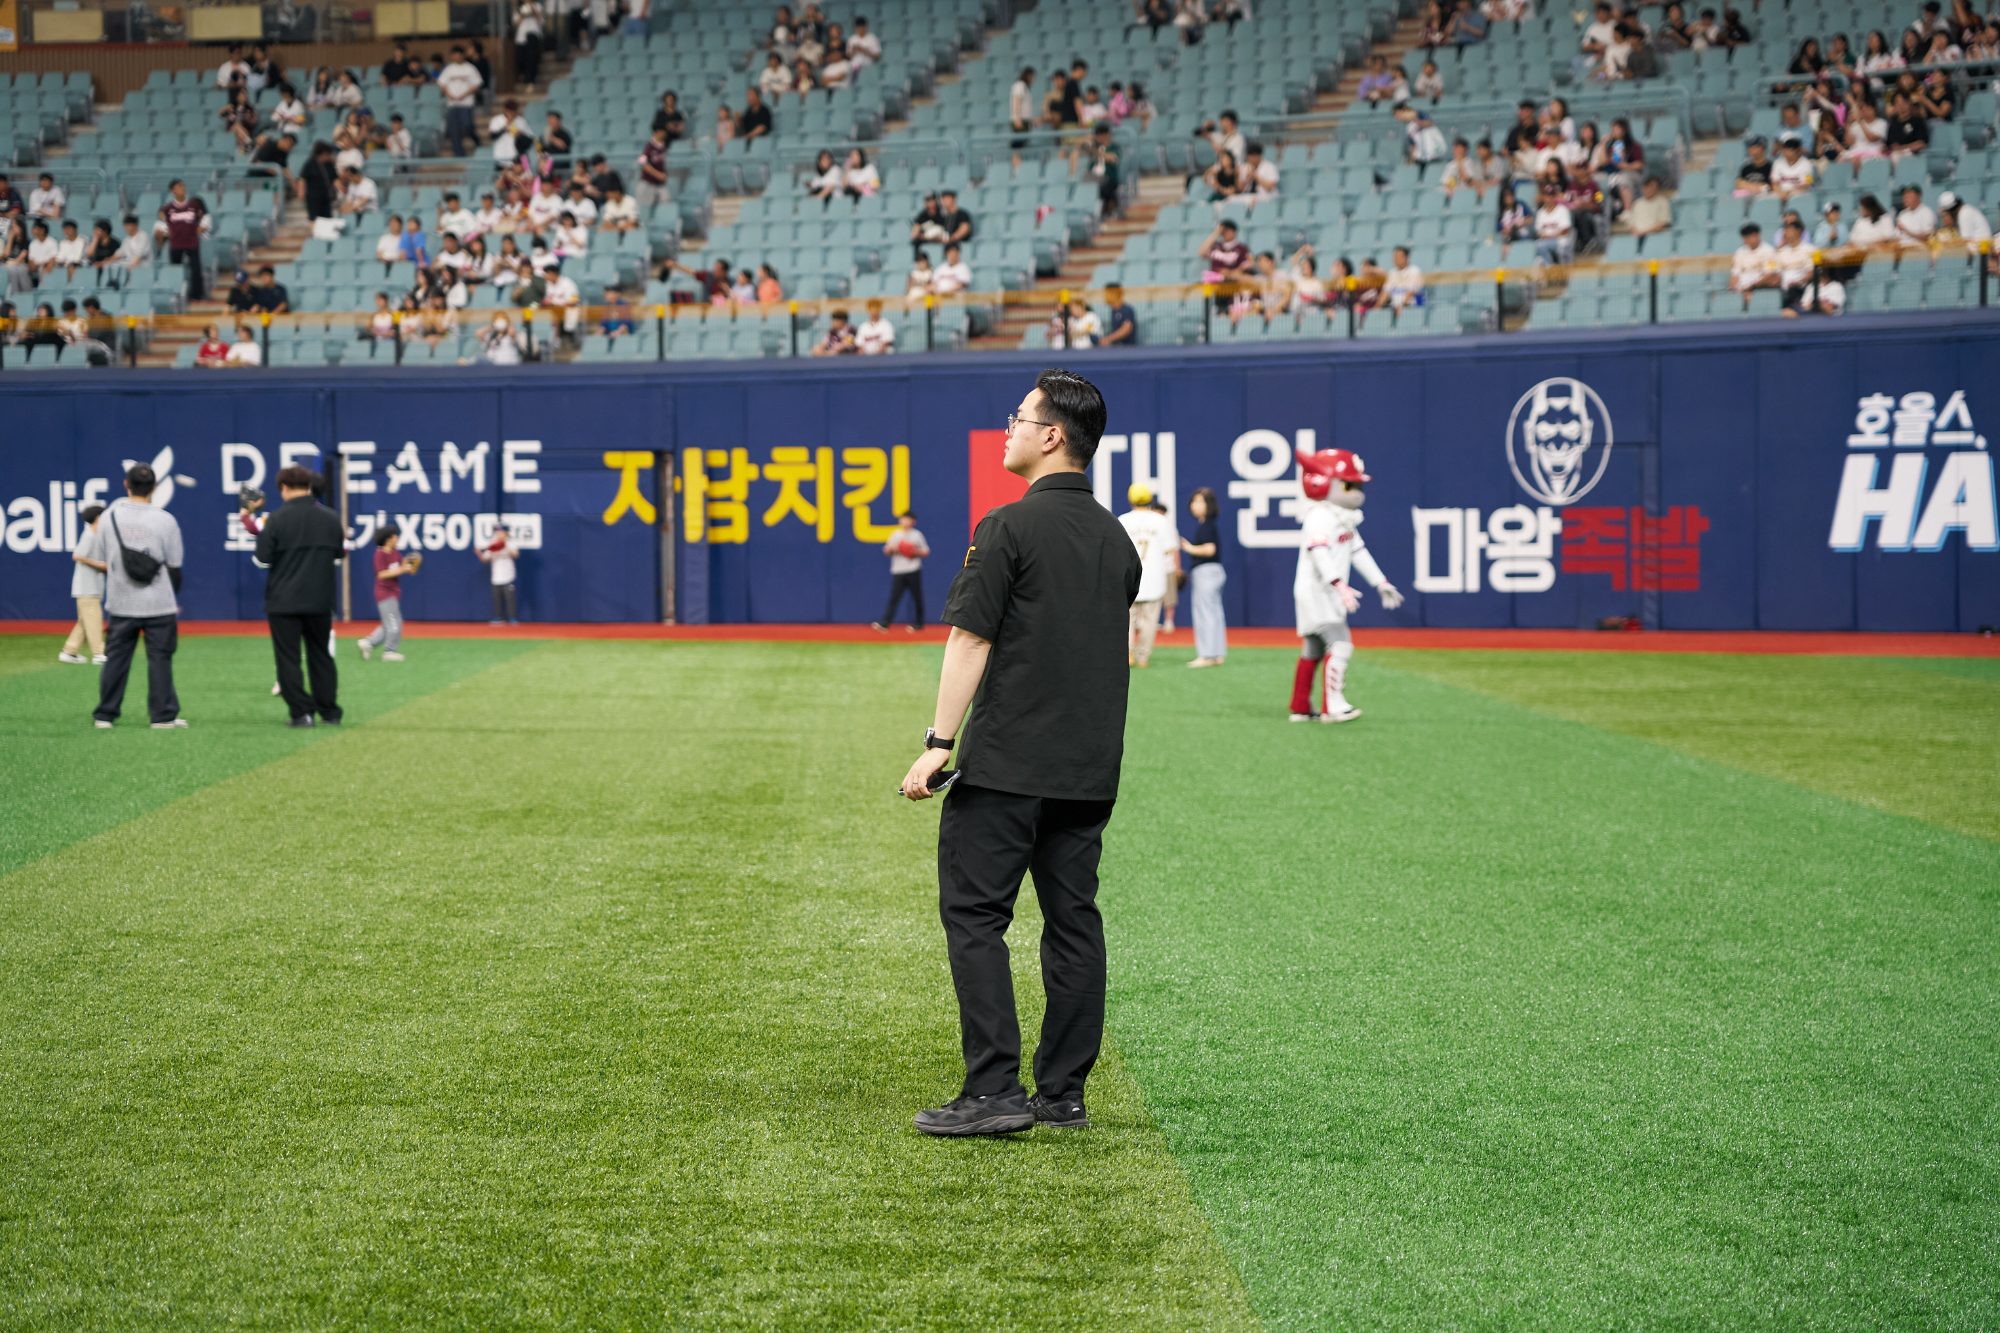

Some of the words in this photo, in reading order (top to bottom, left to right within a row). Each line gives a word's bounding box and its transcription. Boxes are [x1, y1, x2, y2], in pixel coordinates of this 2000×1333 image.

[395, 513, 471, 551] X50
[603, 445, 909, 543] 자담치킨
[1828, 451, 2000, 552] HA
[1411, 503, 1710, 593] 마왕족발
